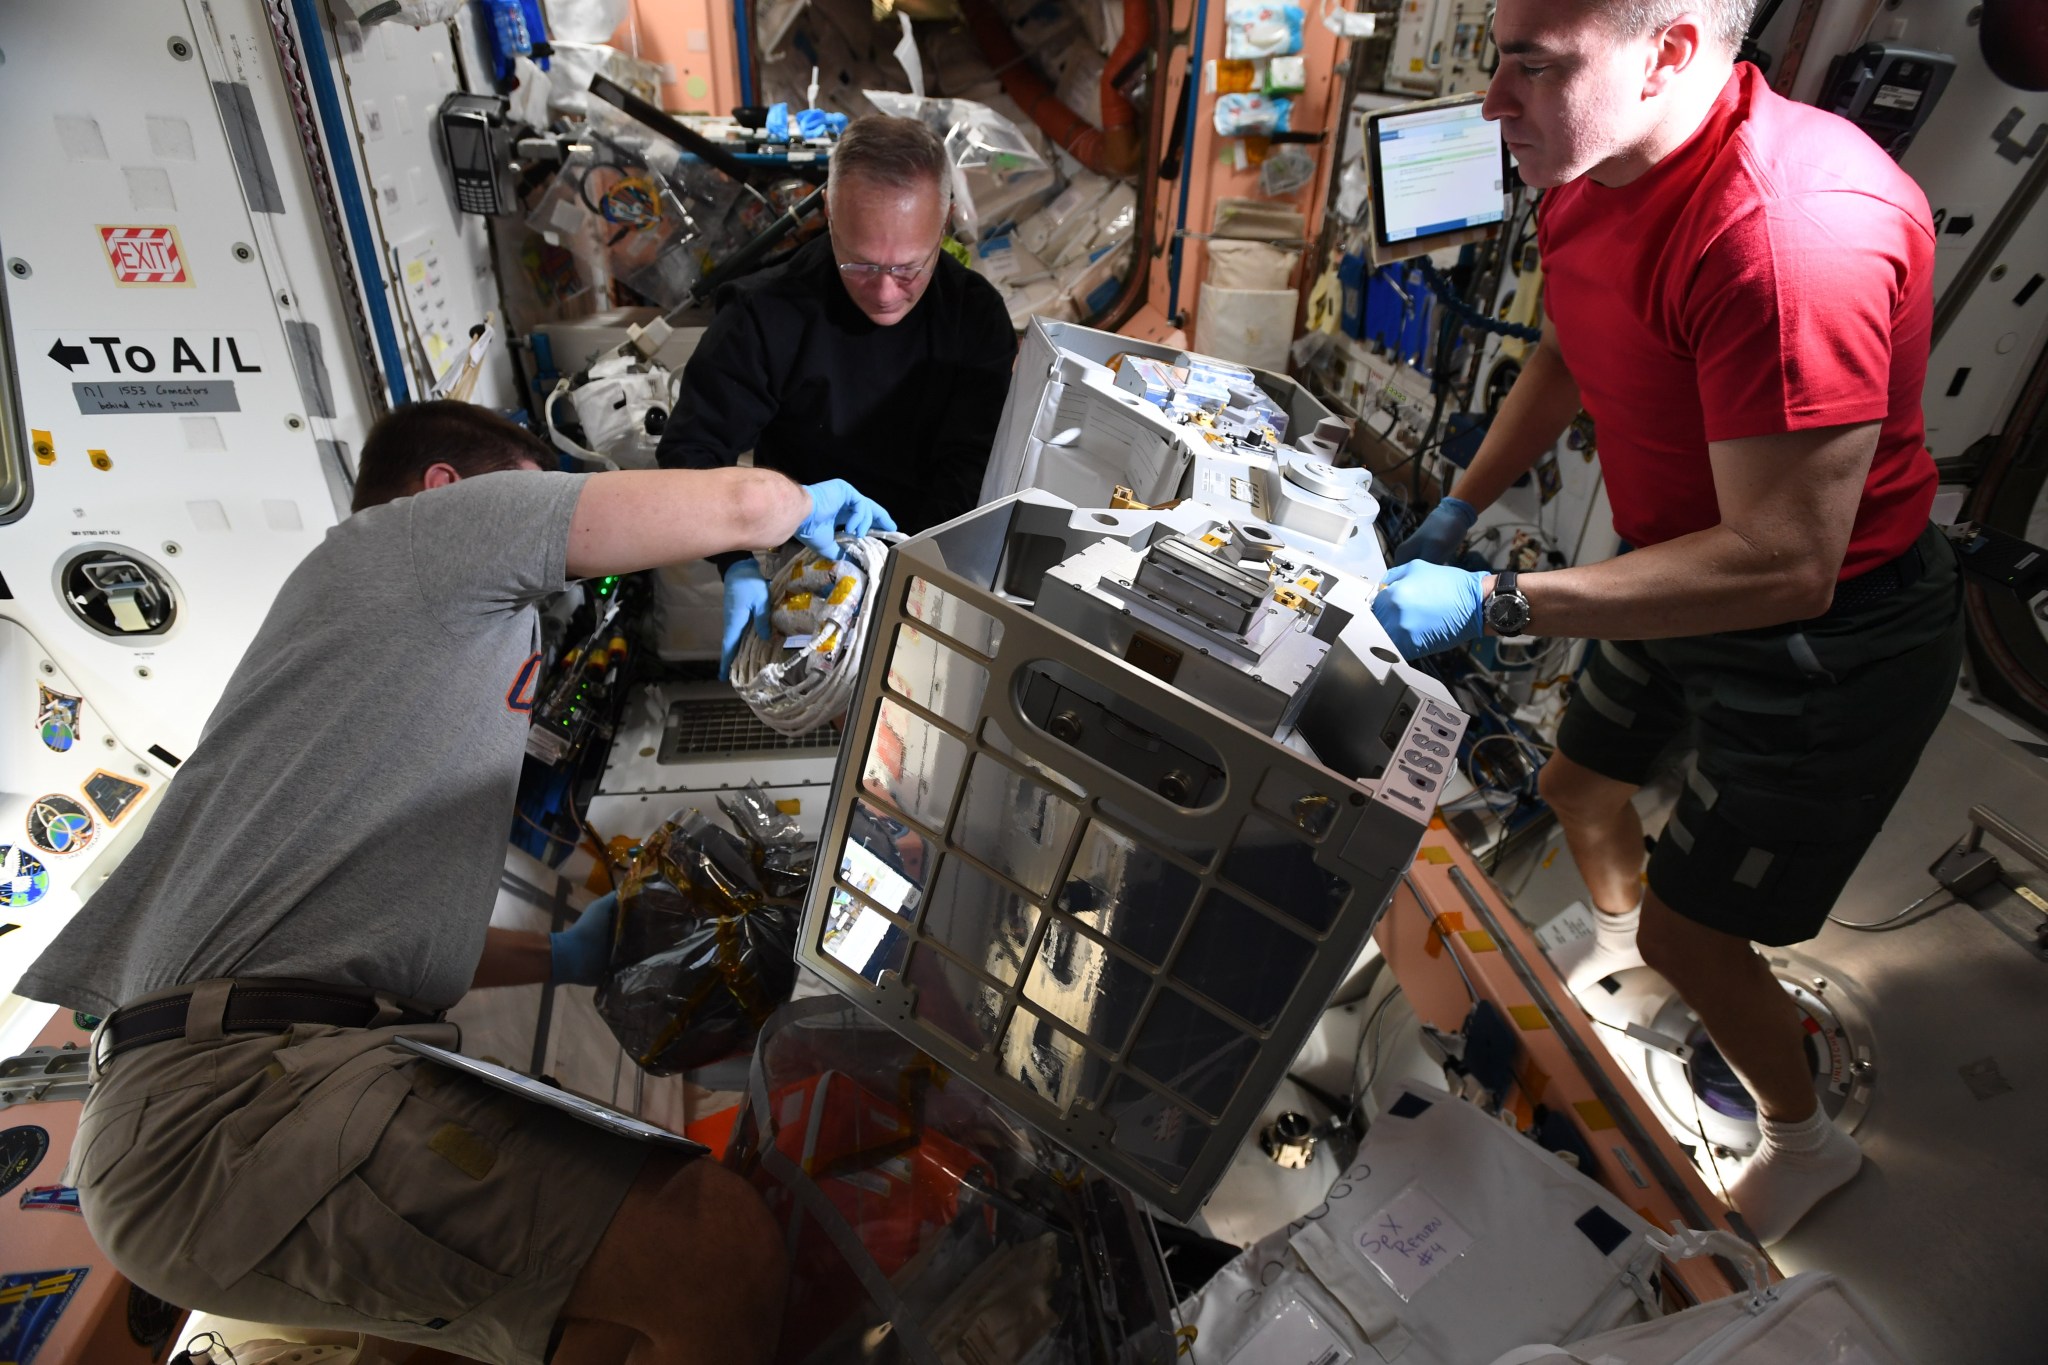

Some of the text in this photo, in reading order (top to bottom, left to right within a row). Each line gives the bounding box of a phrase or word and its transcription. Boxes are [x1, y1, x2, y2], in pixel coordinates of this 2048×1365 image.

[116, 241, 168, 270] EXIT
[88, 336, 263, 374] To A/L
[98, 397, 200, 410] behind this panel
[118, 385, 147, 396] 1553
[1387, 703, 1462, 812] 2PSSP1
[1392, 1216, 1443, 1258] RETURN
[1417, 1241, 1448, 1267] #4
